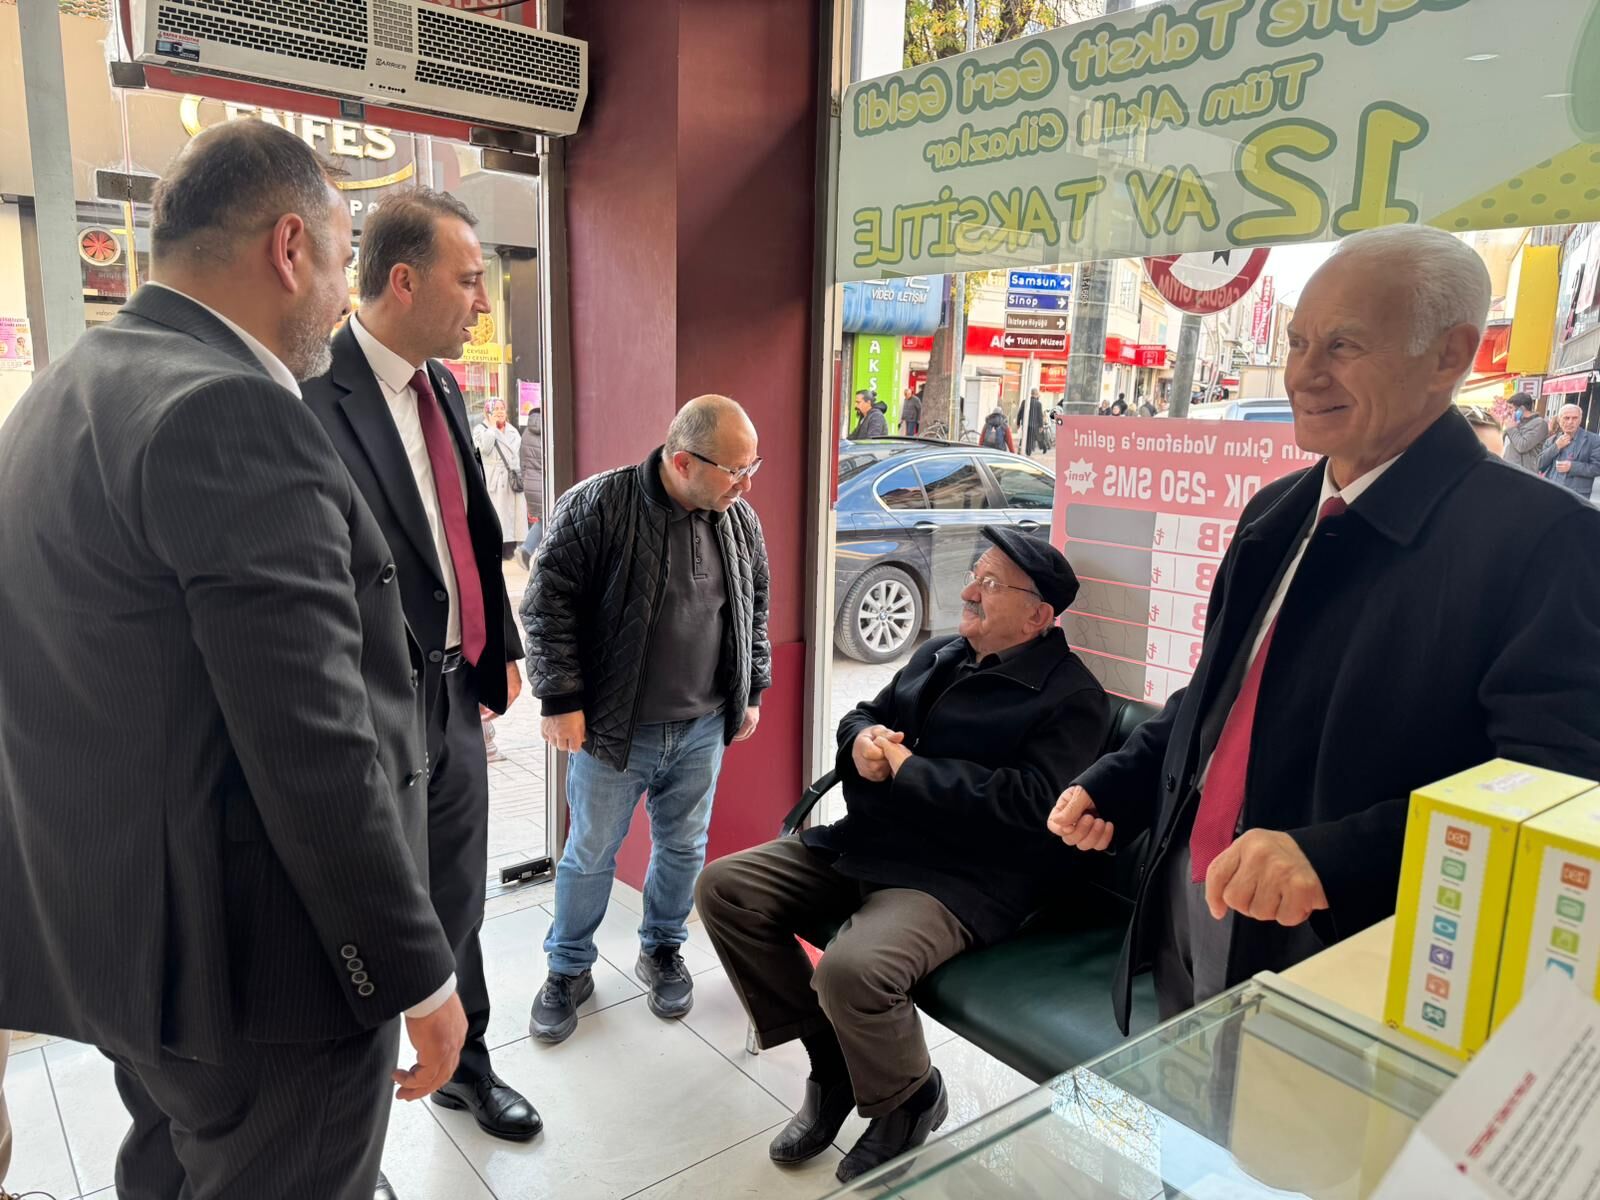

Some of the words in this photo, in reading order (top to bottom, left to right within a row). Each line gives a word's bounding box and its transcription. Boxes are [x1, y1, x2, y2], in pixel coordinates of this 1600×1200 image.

[1011, 275, 1057, 287] Samsun
[1008, 294, 1038, 307] Sinop
[1016, 337, 1038, 345] Tütün
[1040, 337, 1065, 346] Müzesi
